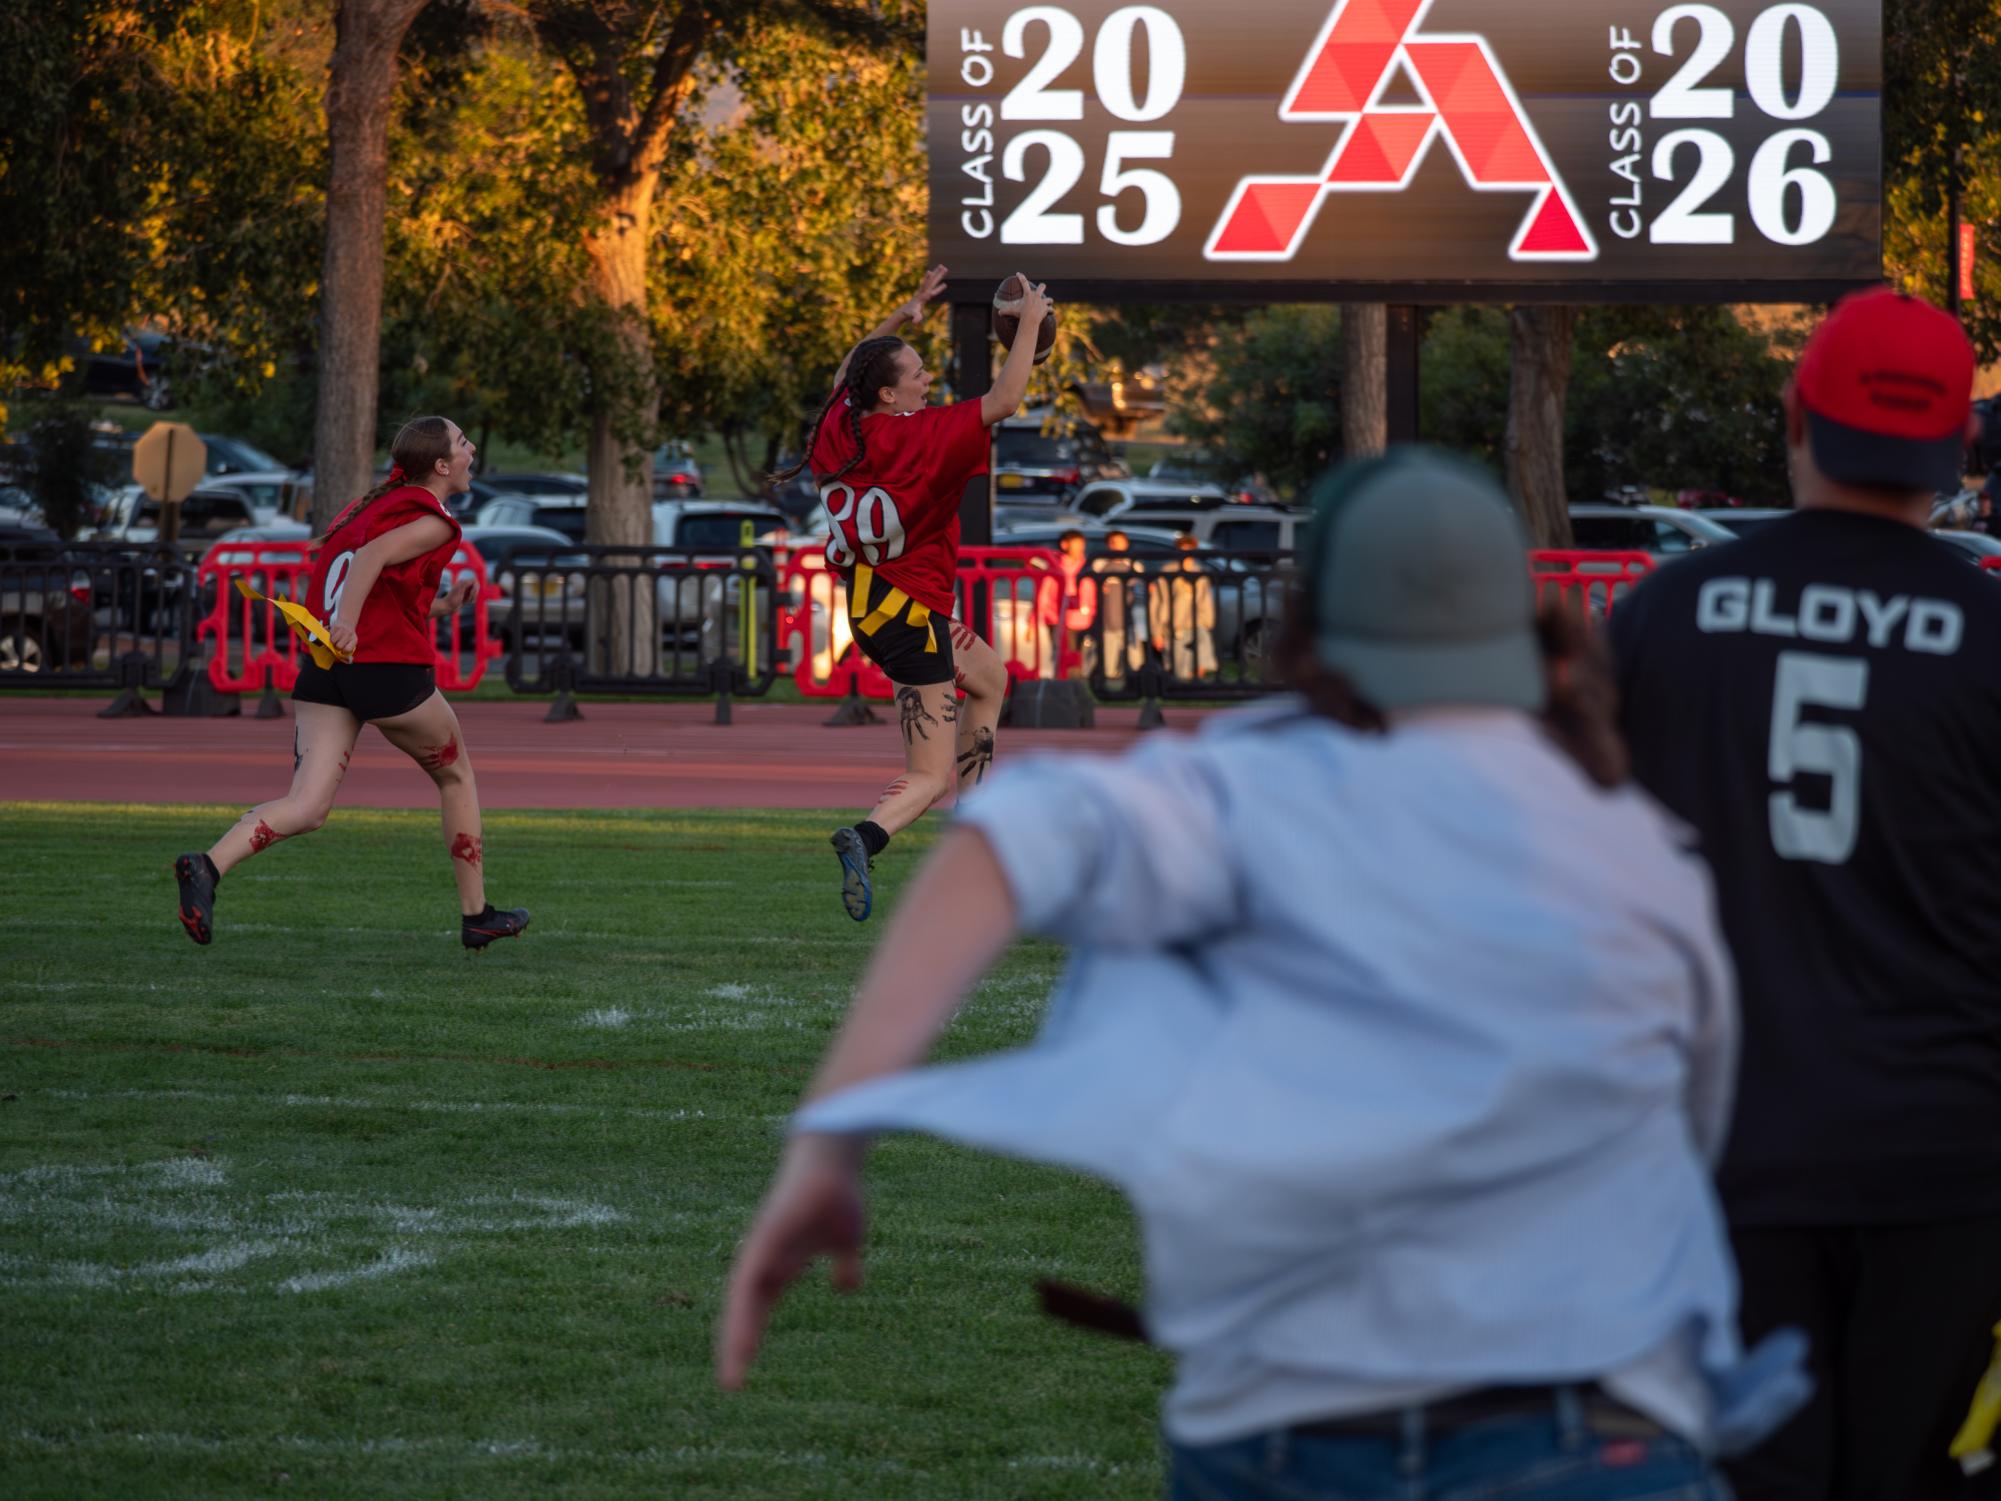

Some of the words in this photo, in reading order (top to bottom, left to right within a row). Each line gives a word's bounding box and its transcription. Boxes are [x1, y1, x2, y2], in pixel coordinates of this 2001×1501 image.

[961, 27, 994, 87] OF
[1001, 5, 1186, 121] 20
[1609, 25, 1642, 85] OF
[1650, 3, 1839, 120] 20
[961, 103, 994, 238] CLASS
[1001, 129, 1182, 246] 25
[1609, 101, 1642, 238] CLASS
[1650, 128, 1838, 246] 26
[819, 481, 906, 568] 89
[1696, 577, 1965, 656] GLOYD
[1768, 649, 1869, 866] 5
